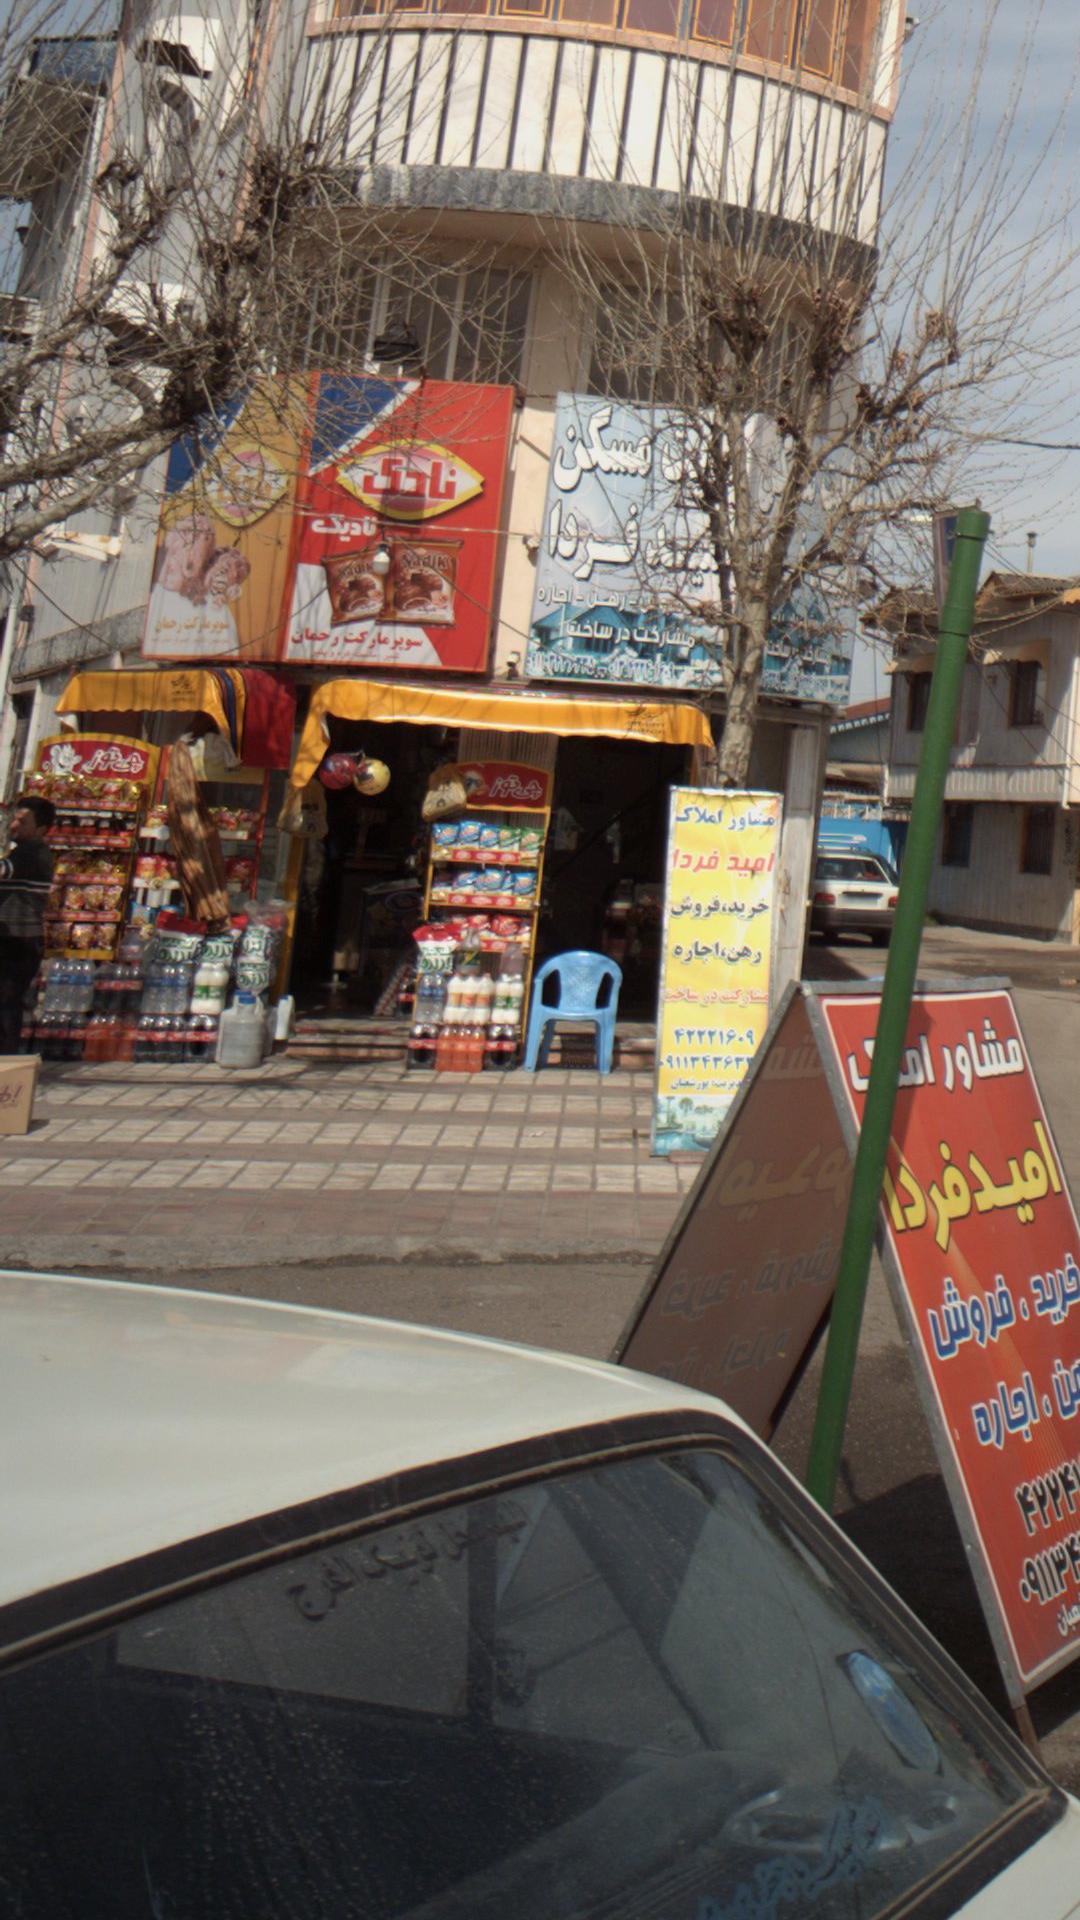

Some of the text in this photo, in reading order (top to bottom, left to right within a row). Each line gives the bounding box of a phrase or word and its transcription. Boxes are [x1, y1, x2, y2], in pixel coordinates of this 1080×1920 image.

[553, 406, 651, 492] مسکن
[549, 498, 640, 581] فردا
[566, 620, 695, 648] مشارکت در ساخت
[675, 806, 776, 832] مشاور املاک
[672, 849, 776, 878] امید فردا
[942, 1018, 1025, 1092] مشاور
[926, 1273, 1017, 1361] فروش
[971, 1371, 1040, 1449] اجاره
